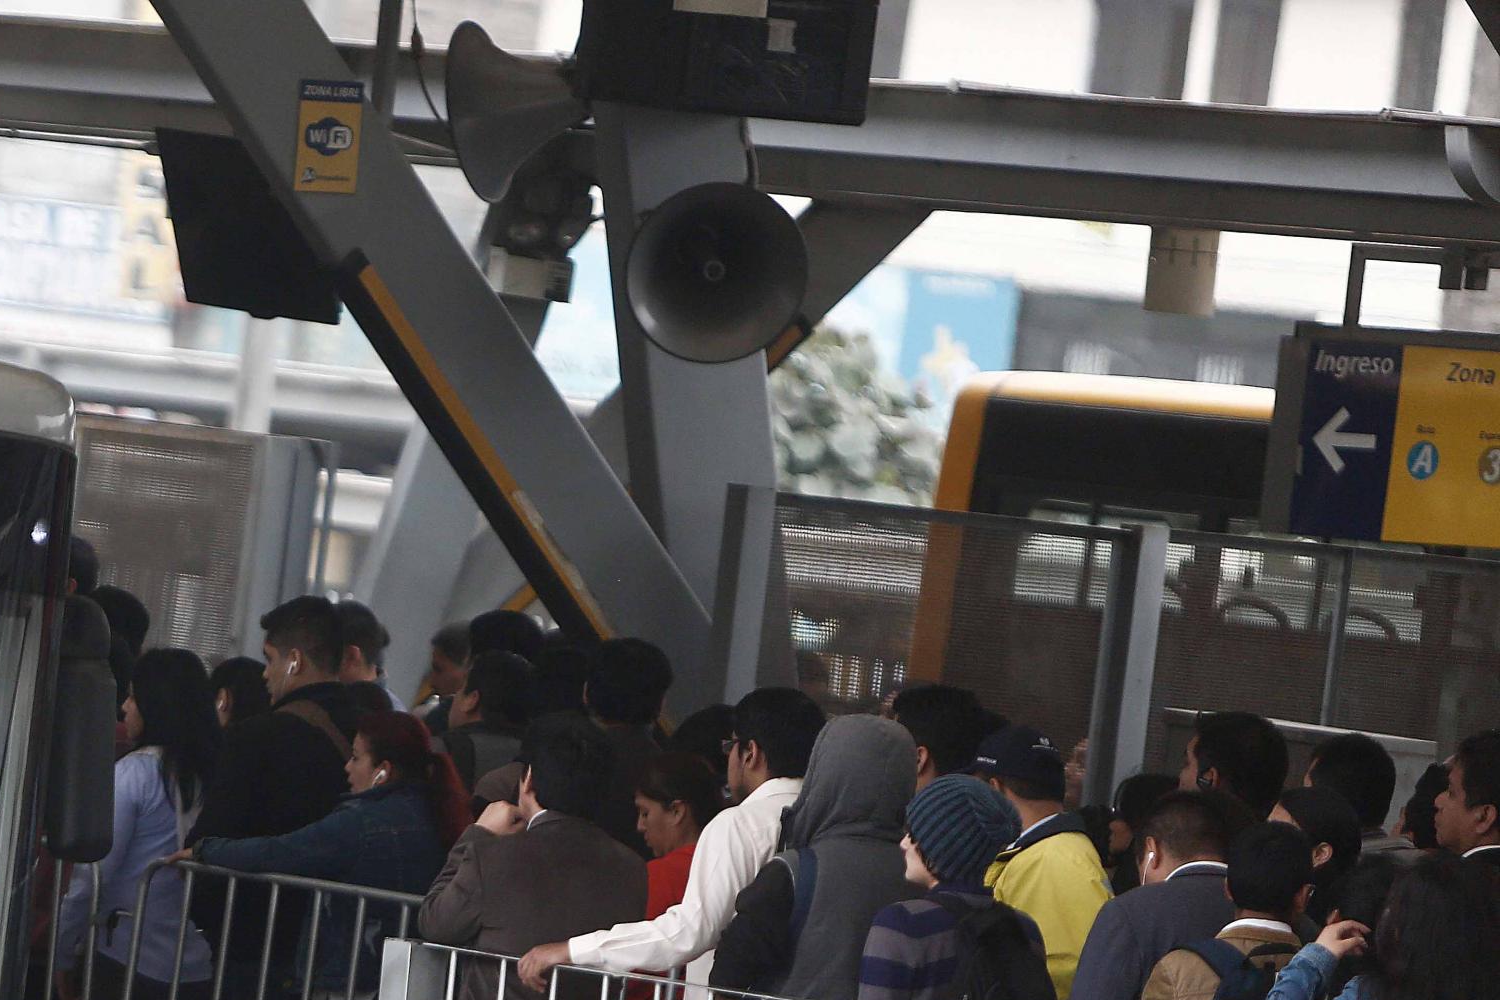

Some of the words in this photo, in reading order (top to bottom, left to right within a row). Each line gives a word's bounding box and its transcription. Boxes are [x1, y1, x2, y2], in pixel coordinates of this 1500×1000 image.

[1315, 350, 1395, 378] Ingreso
[1446, 362, 1496, 385] Zona
[1411, 444, 1434, 474] A
